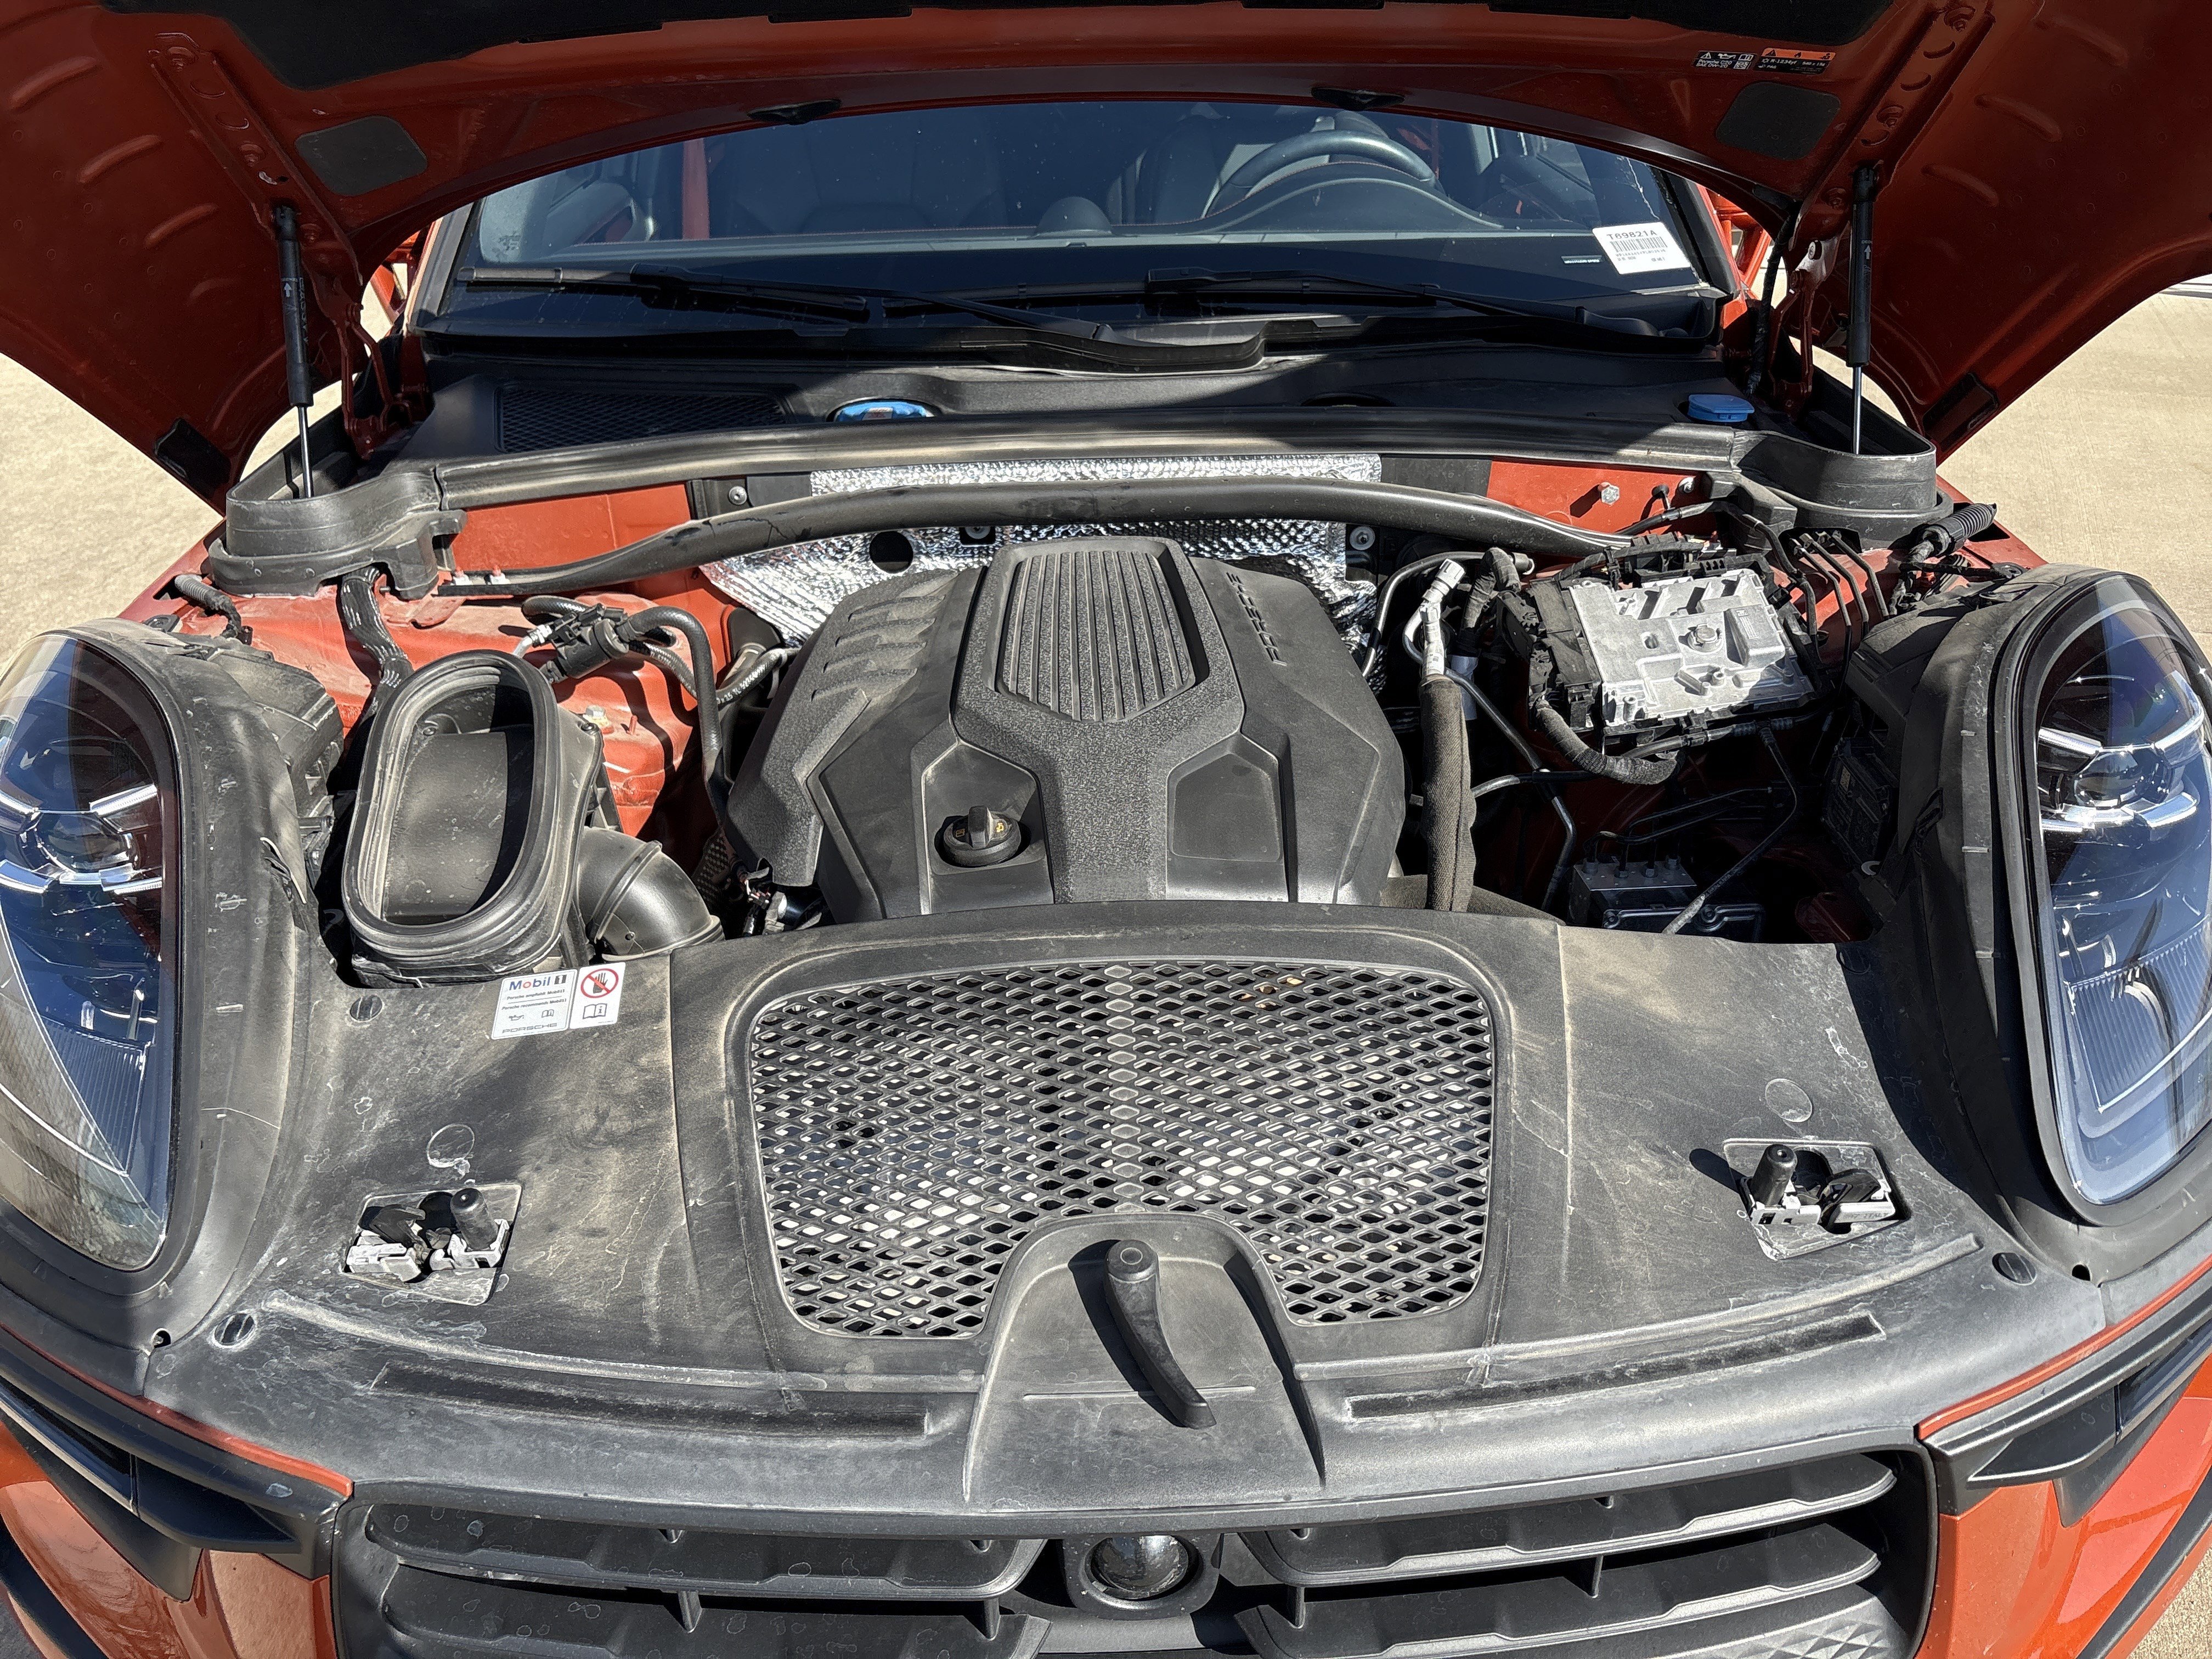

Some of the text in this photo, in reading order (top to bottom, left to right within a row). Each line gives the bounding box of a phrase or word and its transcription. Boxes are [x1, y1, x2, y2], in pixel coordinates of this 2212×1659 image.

[1606, 230, 1657, 240] T69821A
[1225, 572, 1287, 666] PORSCHE
[509, 977, 551, 990] Mobil
[503, 1023, 557, 1033] PORSCHE
